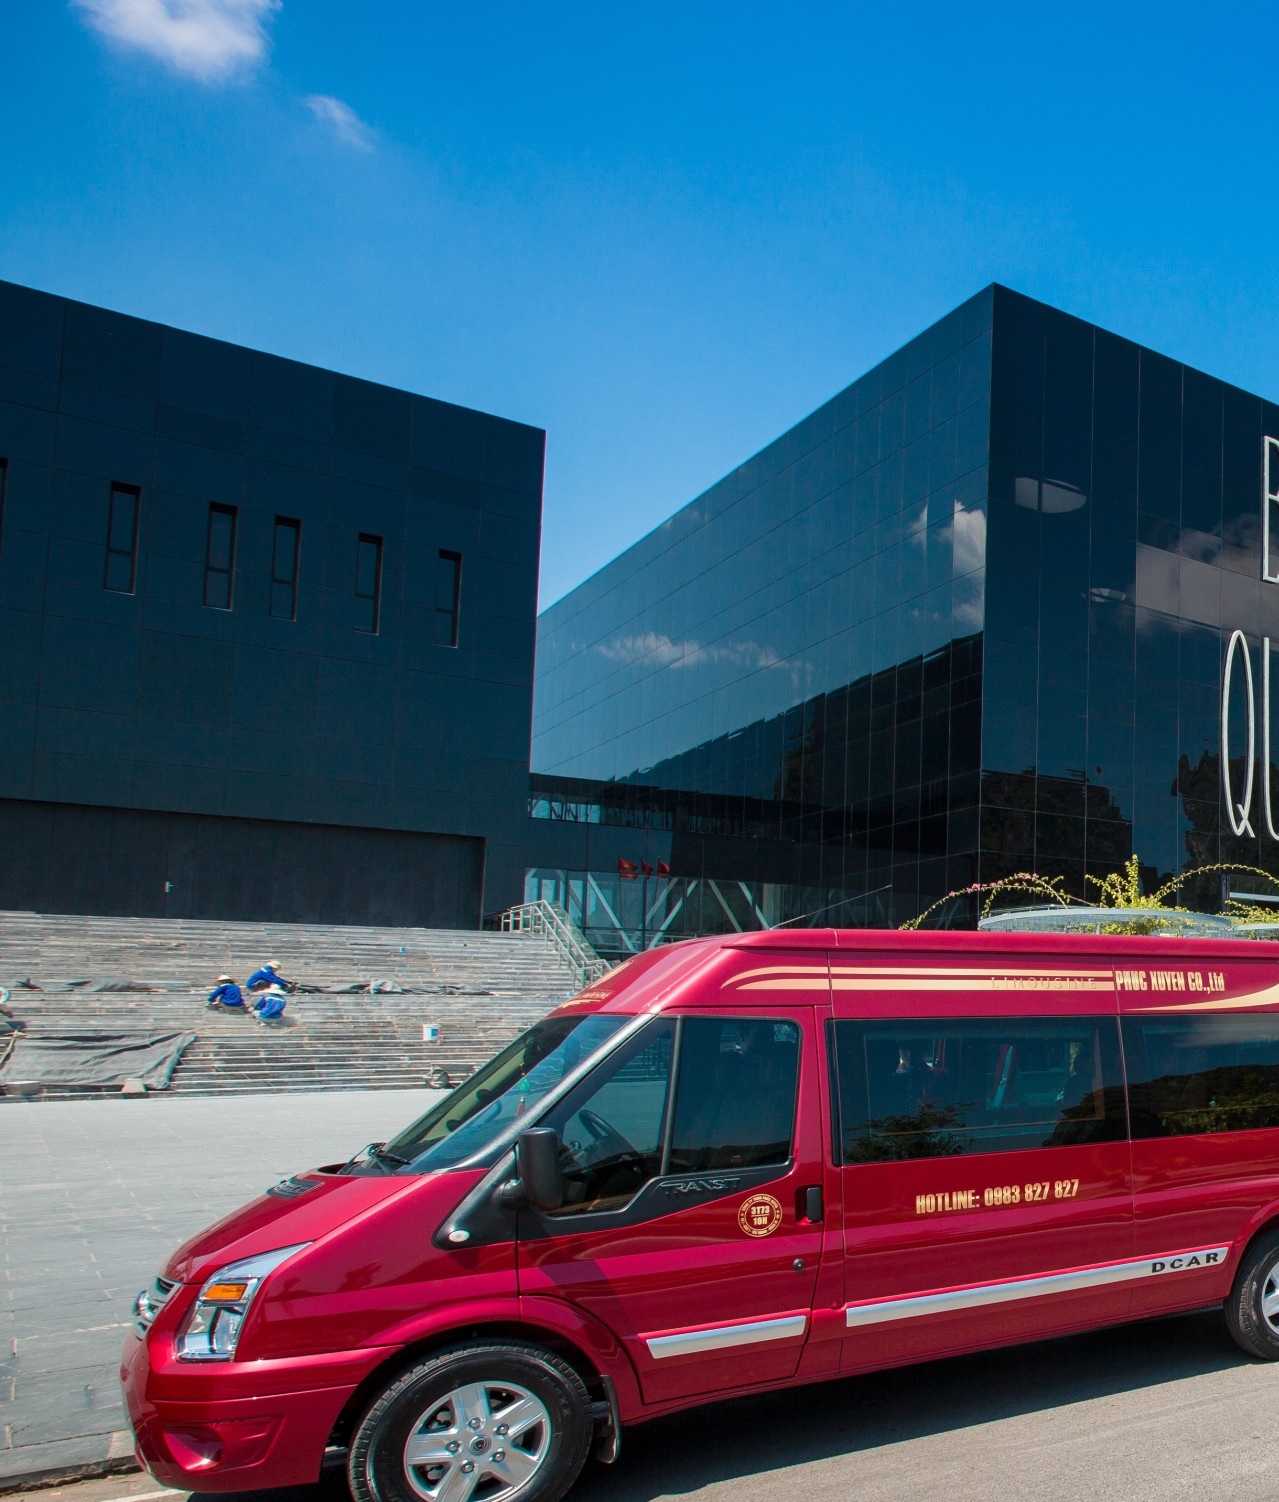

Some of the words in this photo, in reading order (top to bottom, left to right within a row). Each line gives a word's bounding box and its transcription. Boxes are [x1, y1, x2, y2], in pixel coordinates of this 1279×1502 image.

[991, 976, 1097, 990] LIMOUSINE
[916, 1189, 980, 1214] HOTLINE:
[984, 1185, 1021, 1207] 0983
[1024, 1182, 1050, 1202] 827
[1054, 1179, 1080, 1199] 827
[1151, 1252, 1219, 1273] DCAR
